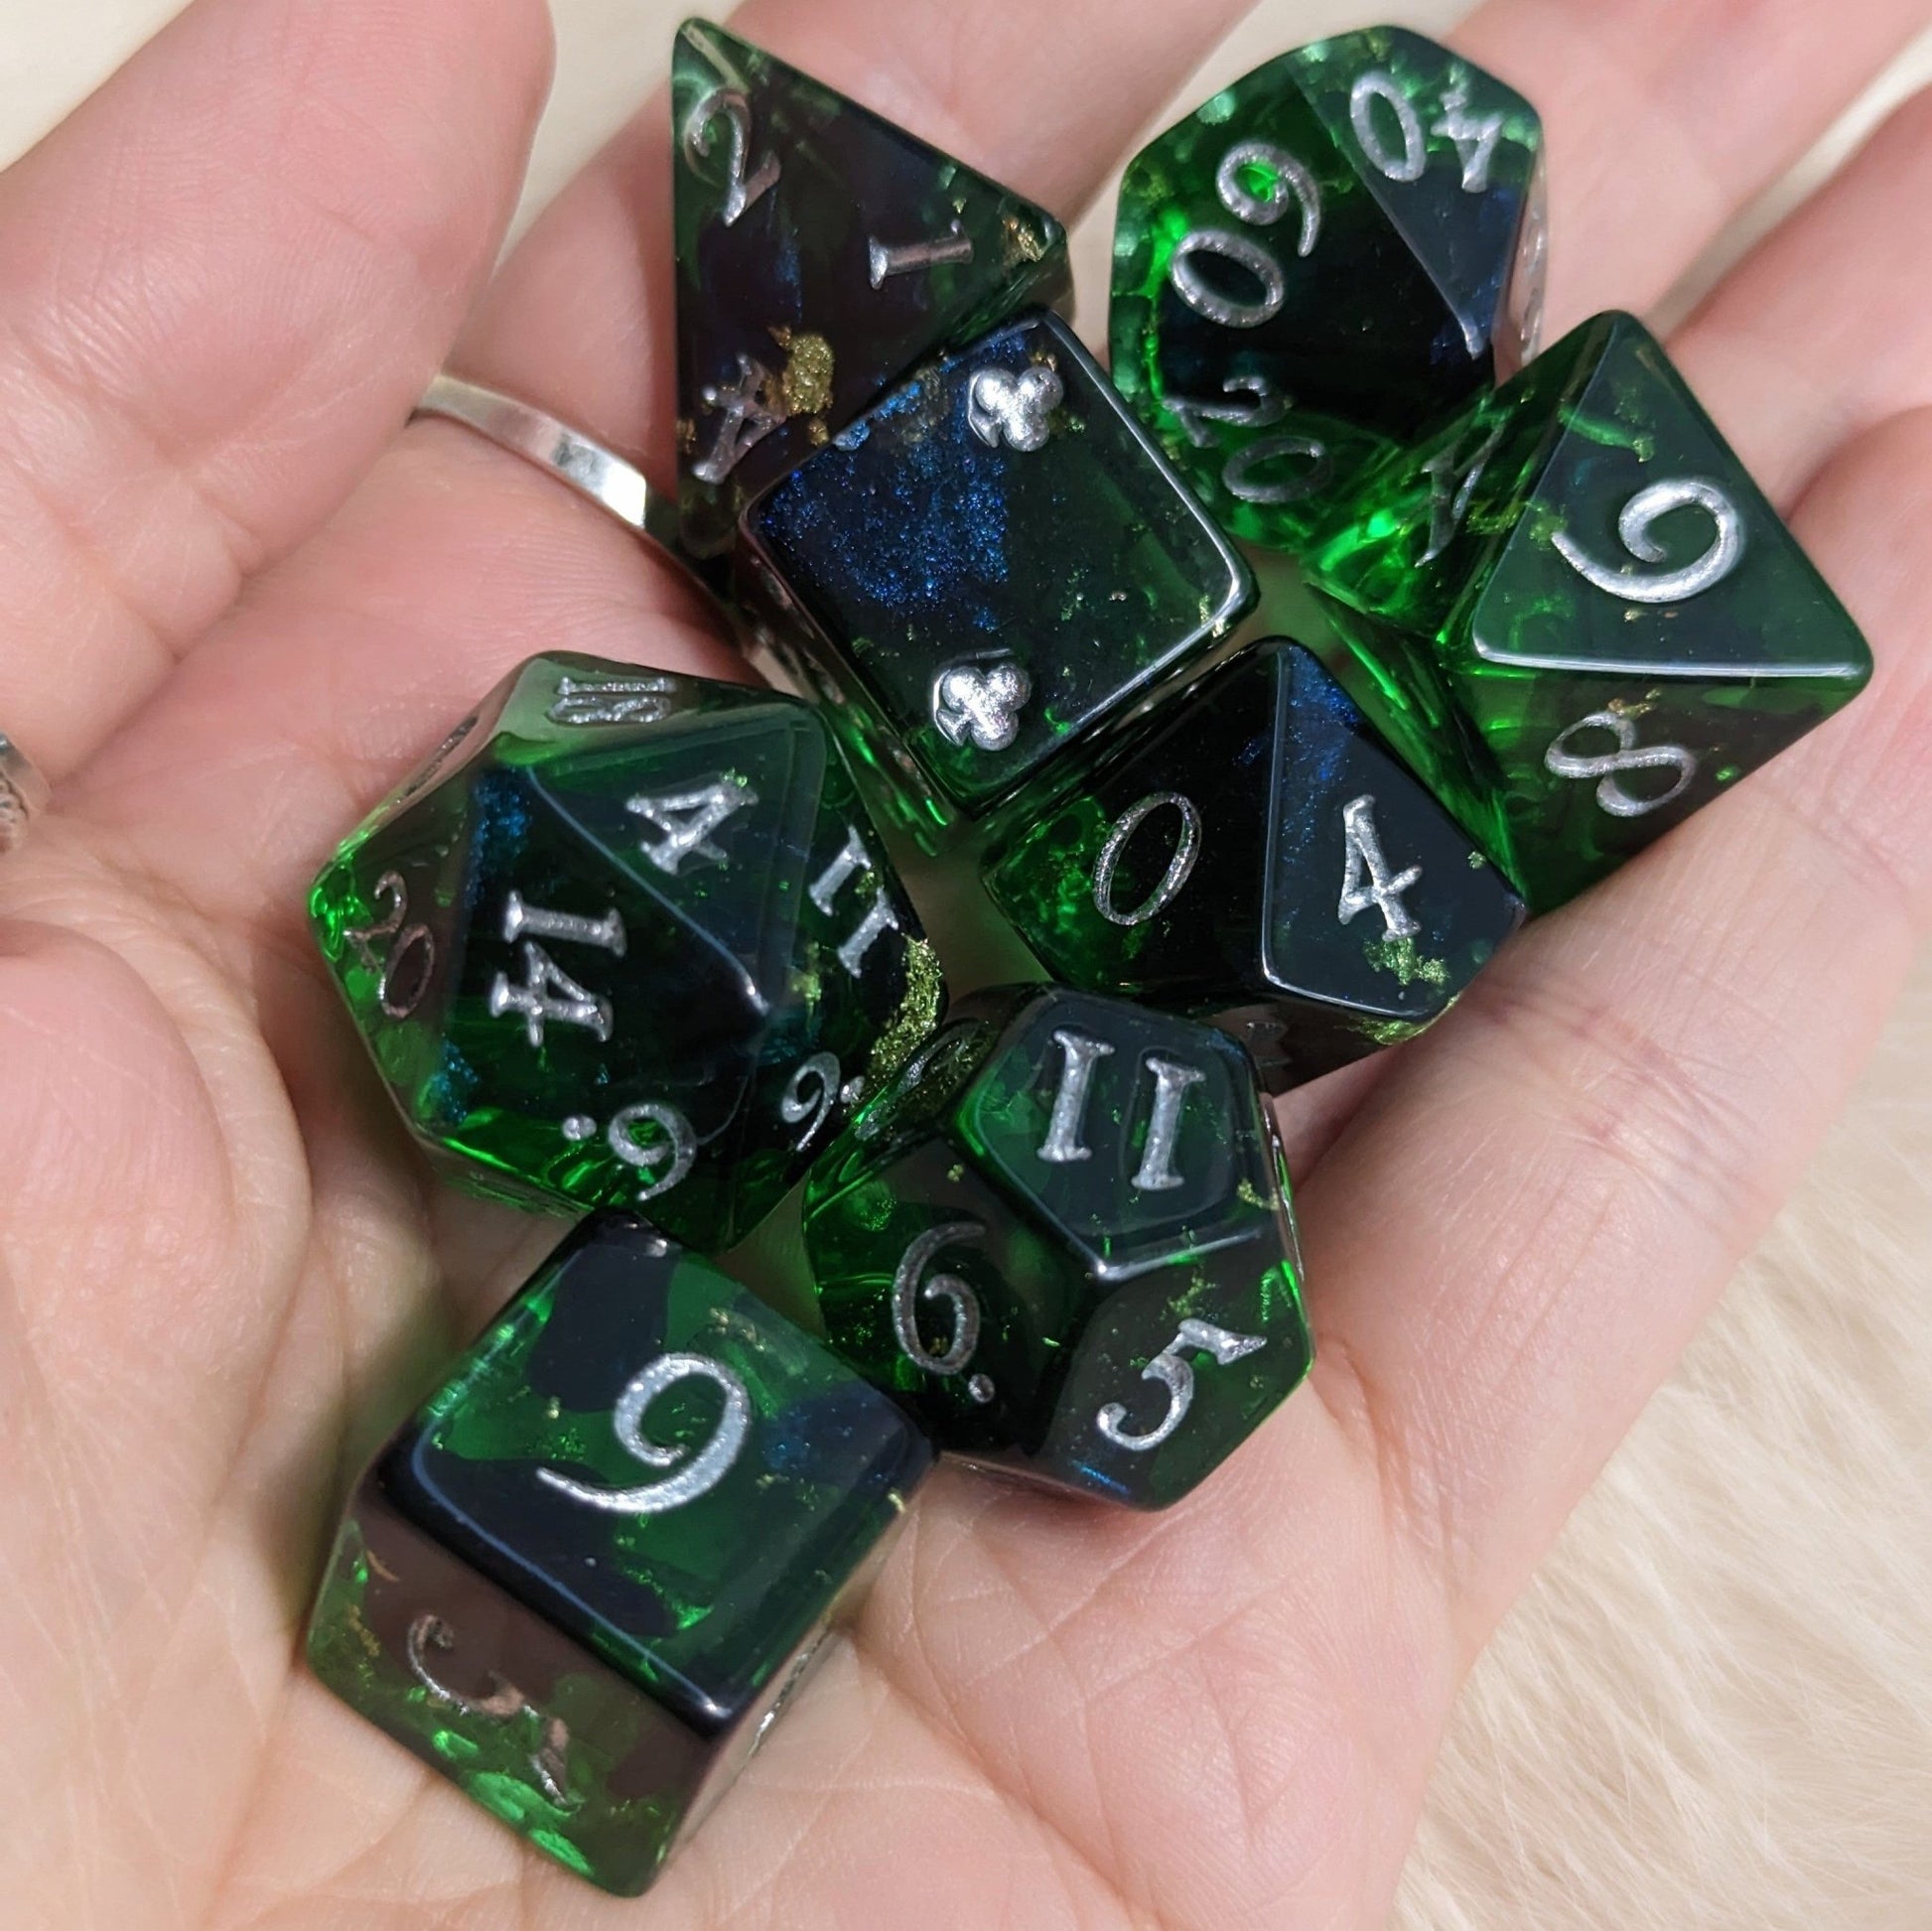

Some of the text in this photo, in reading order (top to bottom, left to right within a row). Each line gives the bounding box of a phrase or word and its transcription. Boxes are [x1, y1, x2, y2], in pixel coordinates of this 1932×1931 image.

[625, 782, 760, 874] 4
[1545, 713, 1696, 817] 8
[1093, 793, 1201, 925] 0
[1338, 794, 1424, 941] 4
[490, 890, 626, 1047] 14
[1036, 1029, 1206, 1191] 11
[1096, 1317, 1268, 1451] 5
